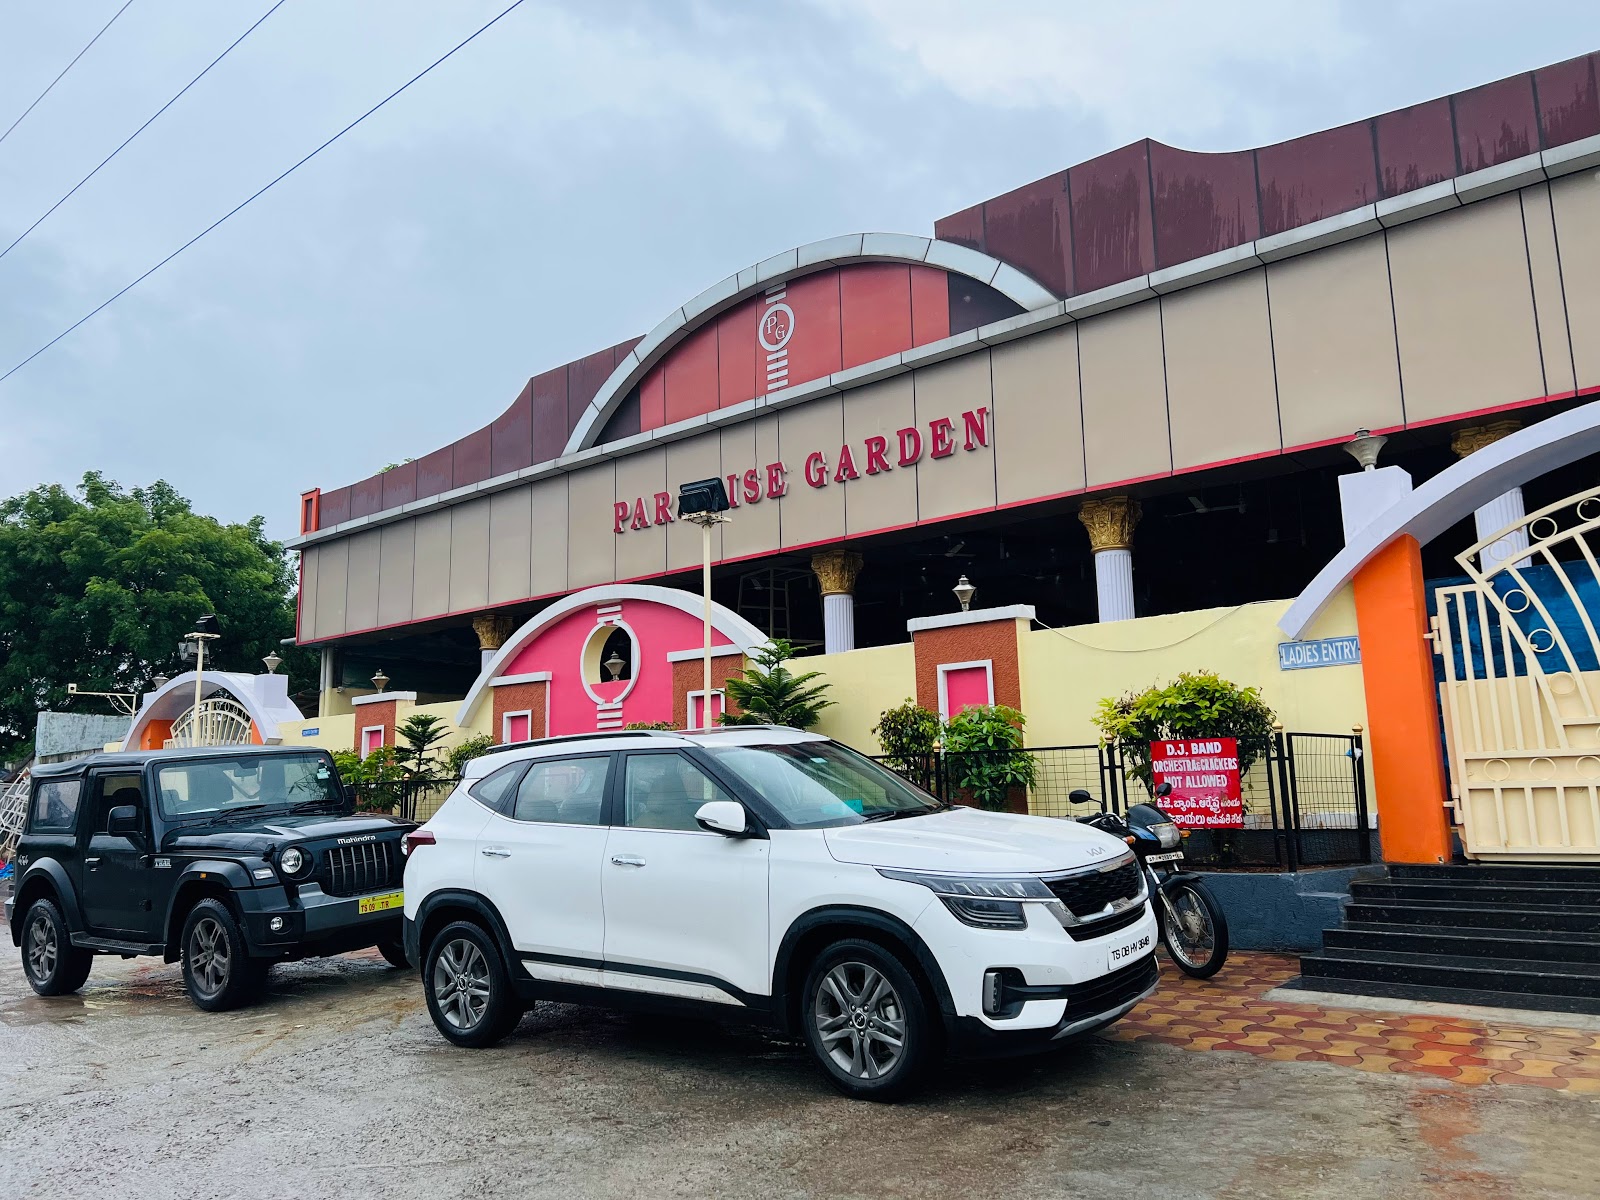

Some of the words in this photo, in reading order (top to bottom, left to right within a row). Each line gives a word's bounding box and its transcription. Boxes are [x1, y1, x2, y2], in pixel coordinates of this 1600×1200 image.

[613, 461, 789, 534] PARISE
[804, 406, 990, 489] GARDEN
[1282, 644, 1319, 665] LADIES
[1321, 640, 1357, 661] ENTRY
[1191, 741, 1222, 755] BAND
[1185, 774, 1228, 788] ALLOWED
[337, 835, 376, 845] Mahindra
[1111, 949, 1121, 961] TS
